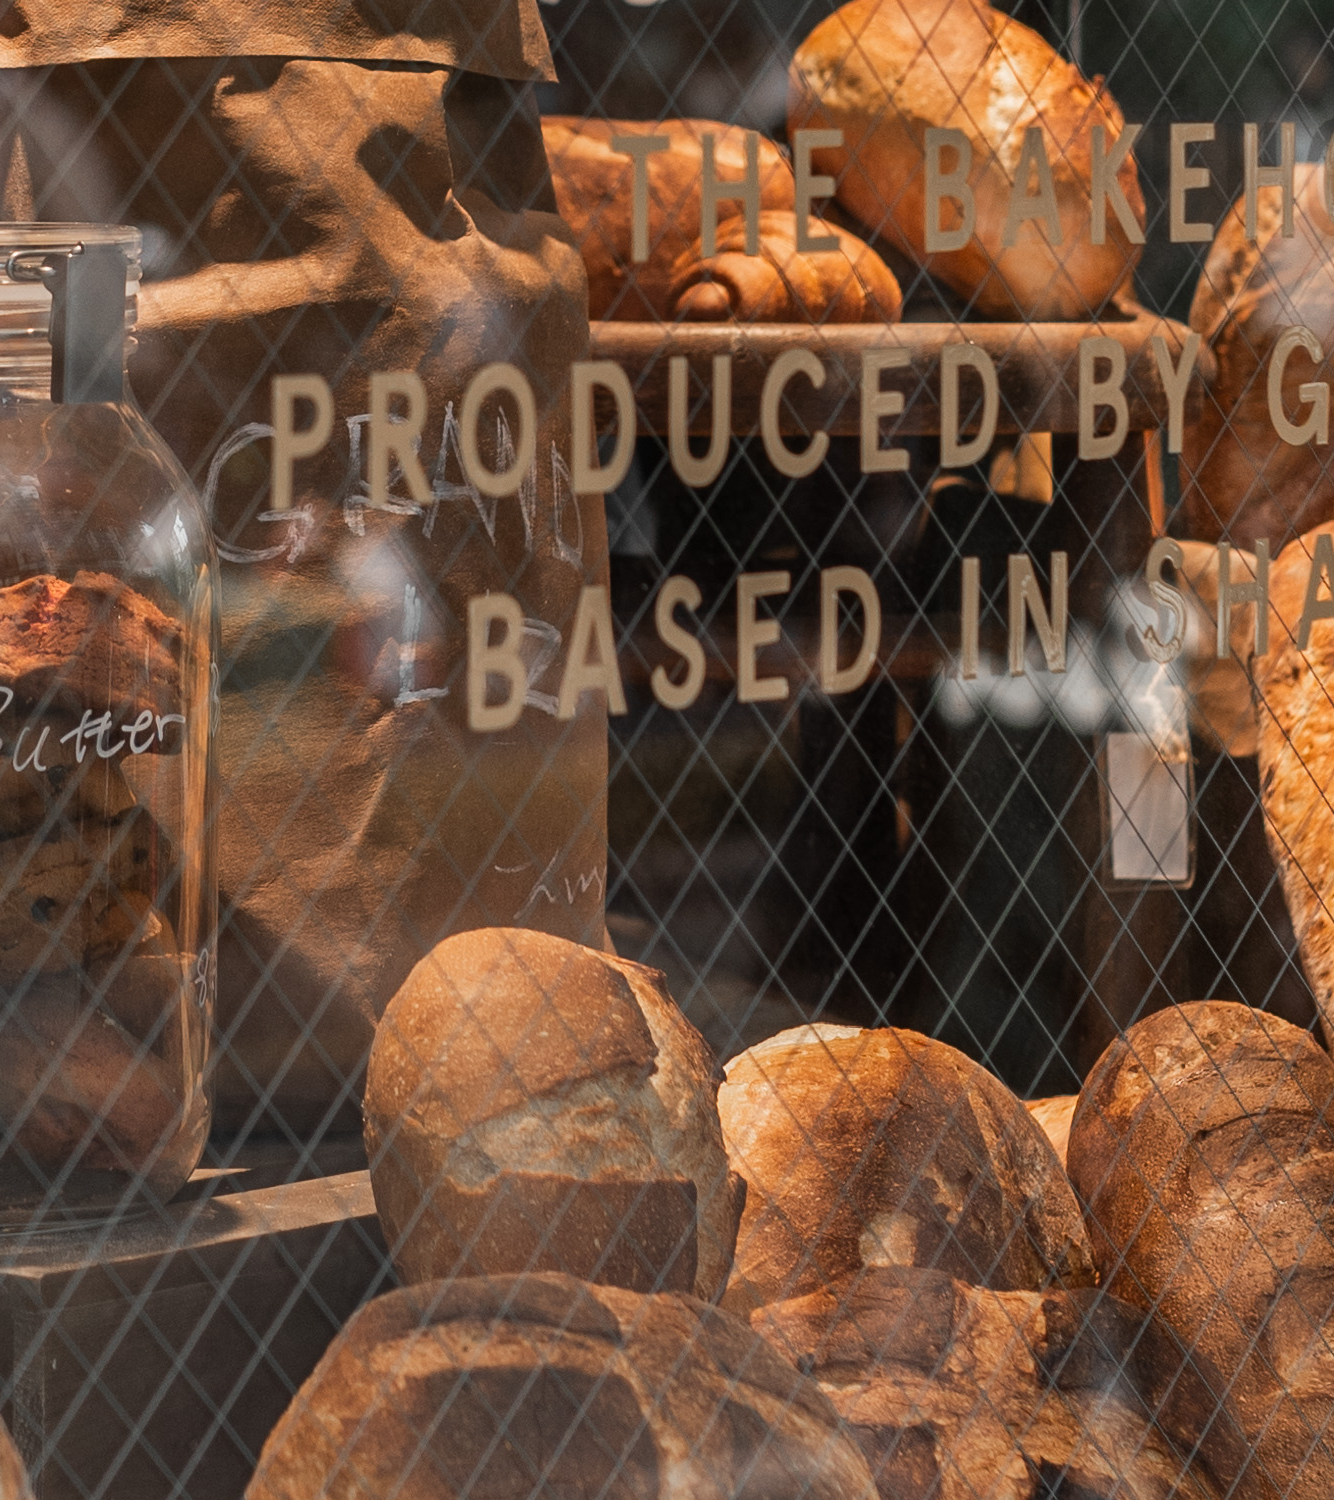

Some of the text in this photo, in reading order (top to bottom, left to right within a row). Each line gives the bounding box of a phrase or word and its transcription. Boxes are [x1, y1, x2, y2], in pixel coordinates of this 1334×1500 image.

[611, 128, 845, 263] THE
[271, 342, 1001, 512] PRODUCED
[1078, 332, 1204, 462] BY
[467, 564, 883, 733] BASED
[959, 551, 1068, 681] IN
